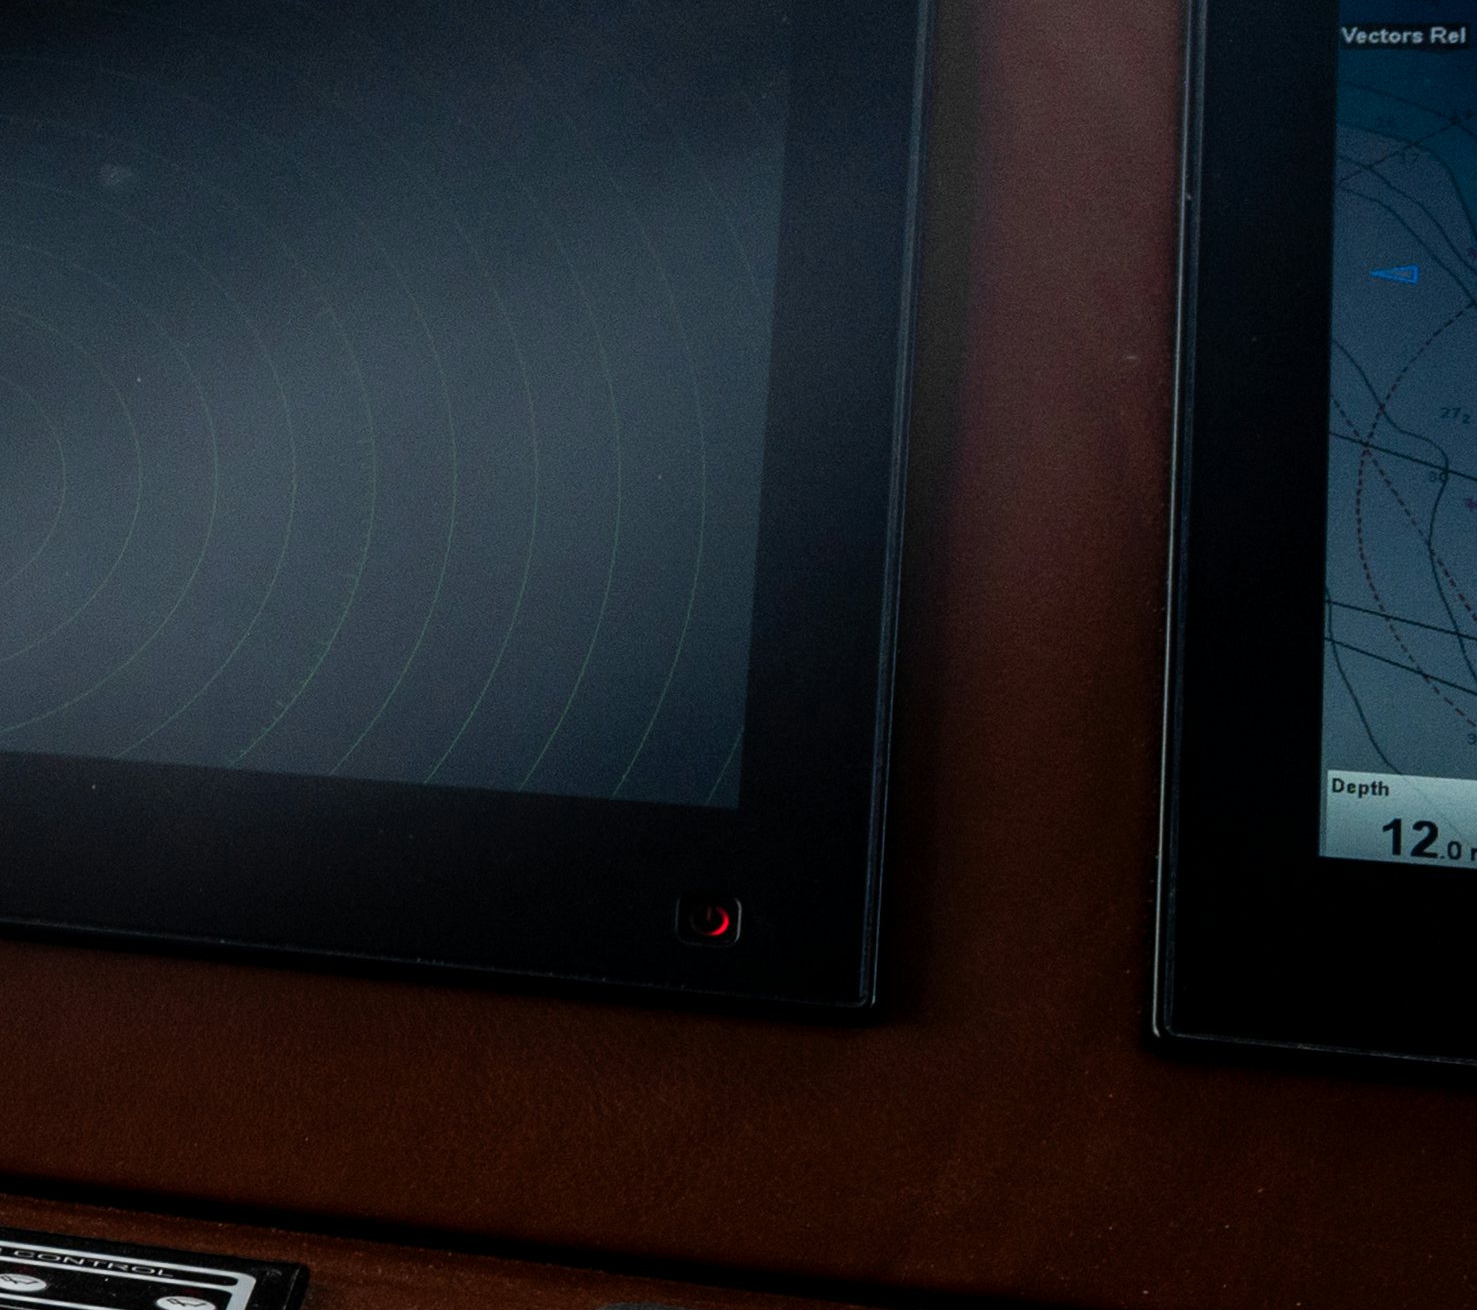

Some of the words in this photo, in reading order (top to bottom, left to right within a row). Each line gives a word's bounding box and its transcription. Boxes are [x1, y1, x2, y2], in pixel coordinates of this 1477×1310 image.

[1341, 26, 1423, 44] Vectors
[1430, 27, 1467, 44] Rel
[1331, 777, 1390, 798] Depth
[1382, 818, 1463, 861] 12.0
[13, 1249, 174, 1278] CONTROL
